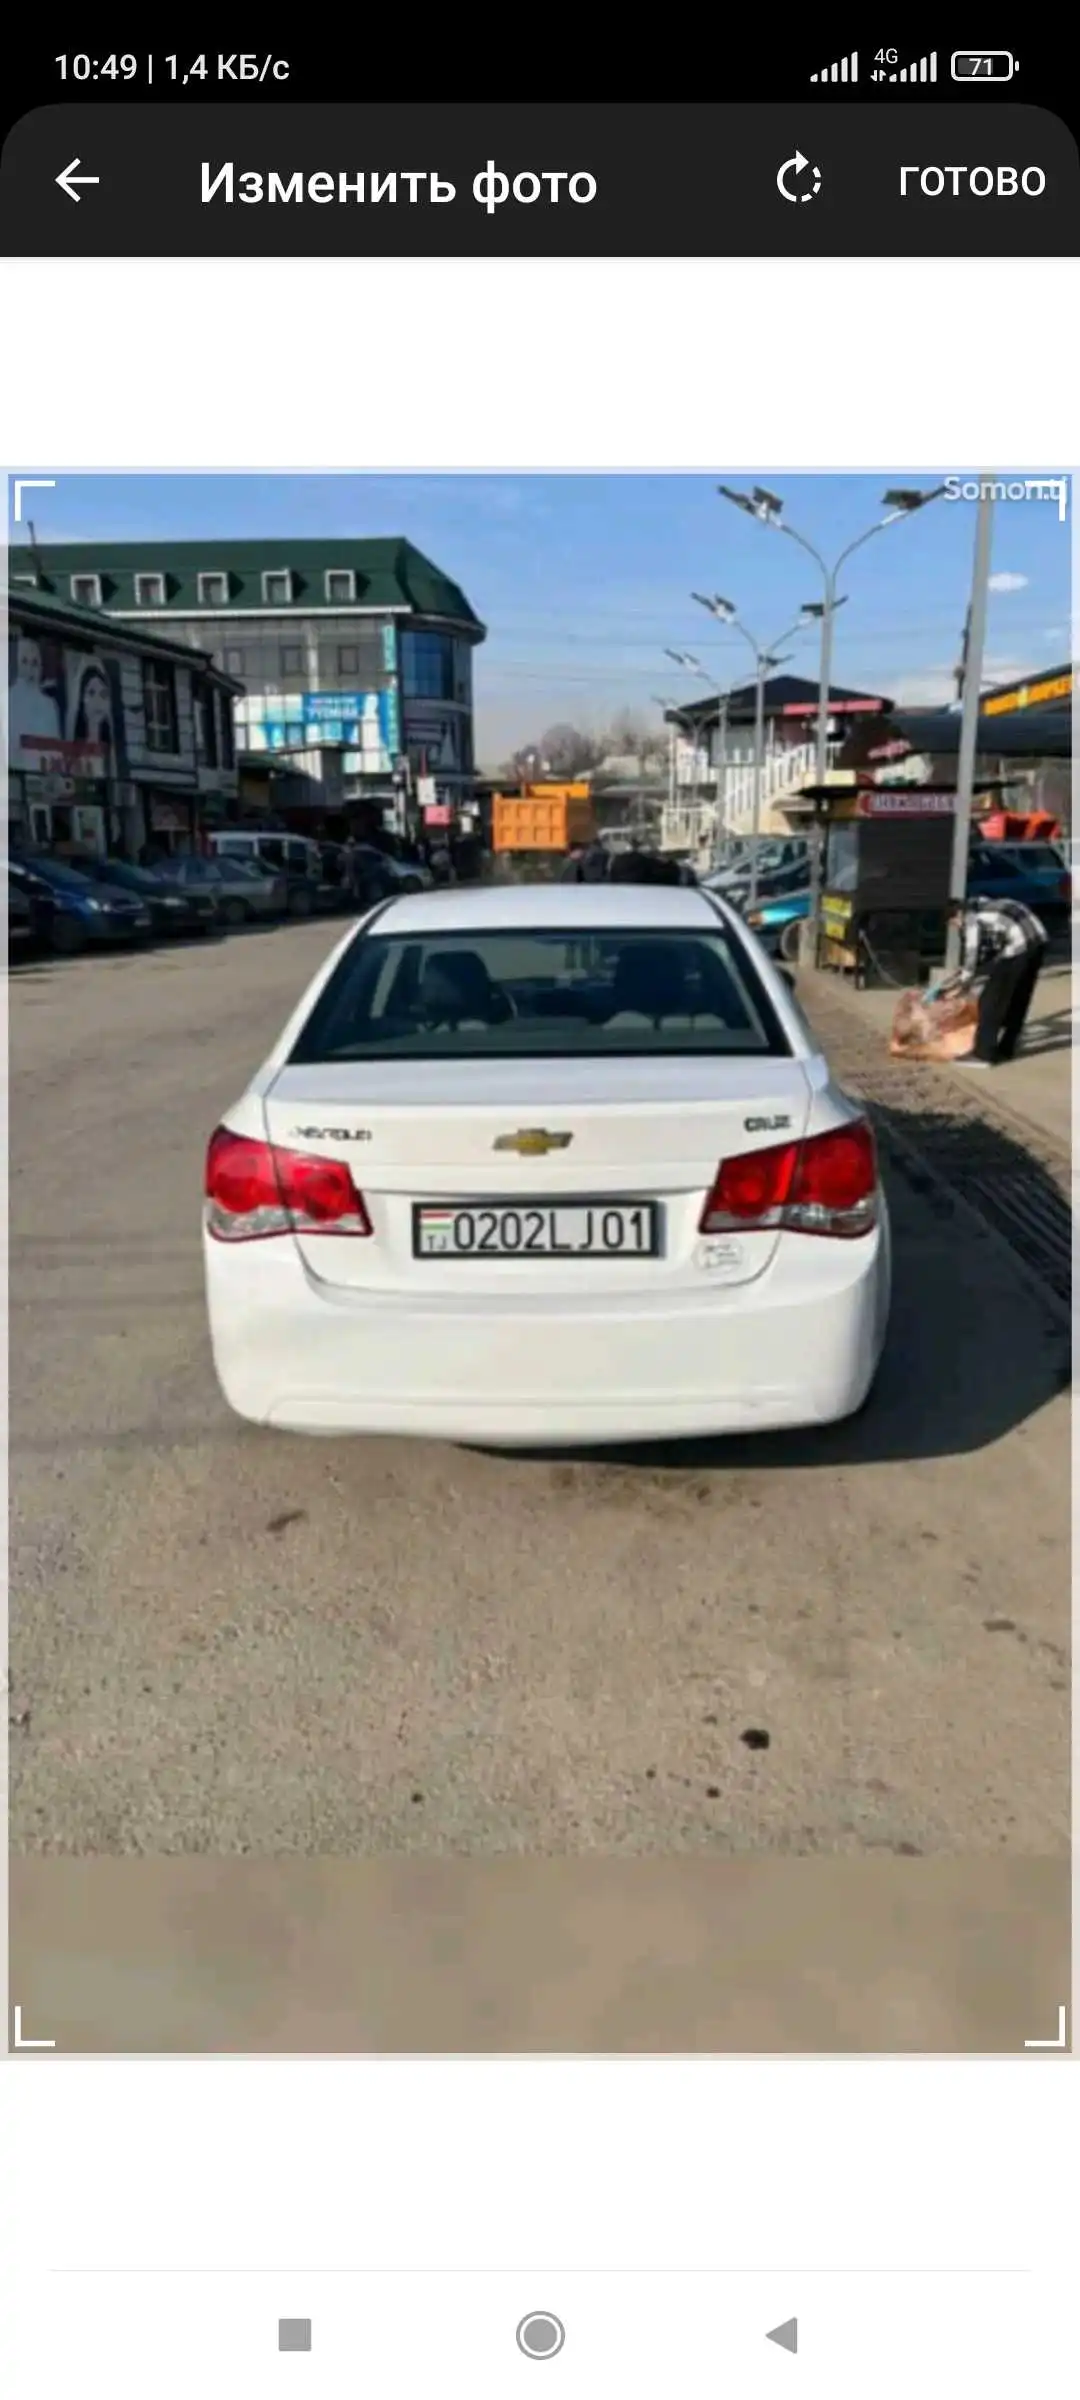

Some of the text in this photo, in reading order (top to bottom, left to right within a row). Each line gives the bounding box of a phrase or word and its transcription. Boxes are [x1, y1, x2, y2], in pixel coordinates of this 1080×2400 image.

[56, 54, 137, 79] 10:49
[166, 55, 208, 84] 1,4
[218, 55, 289, 81] КБ/с
[874, 48, 897, 63] 4G
[969, 58, 991, 75] 71
[202, 160, 596, 214] Изменить фото
[901, 167, 1045, 196] ГОТОВО
